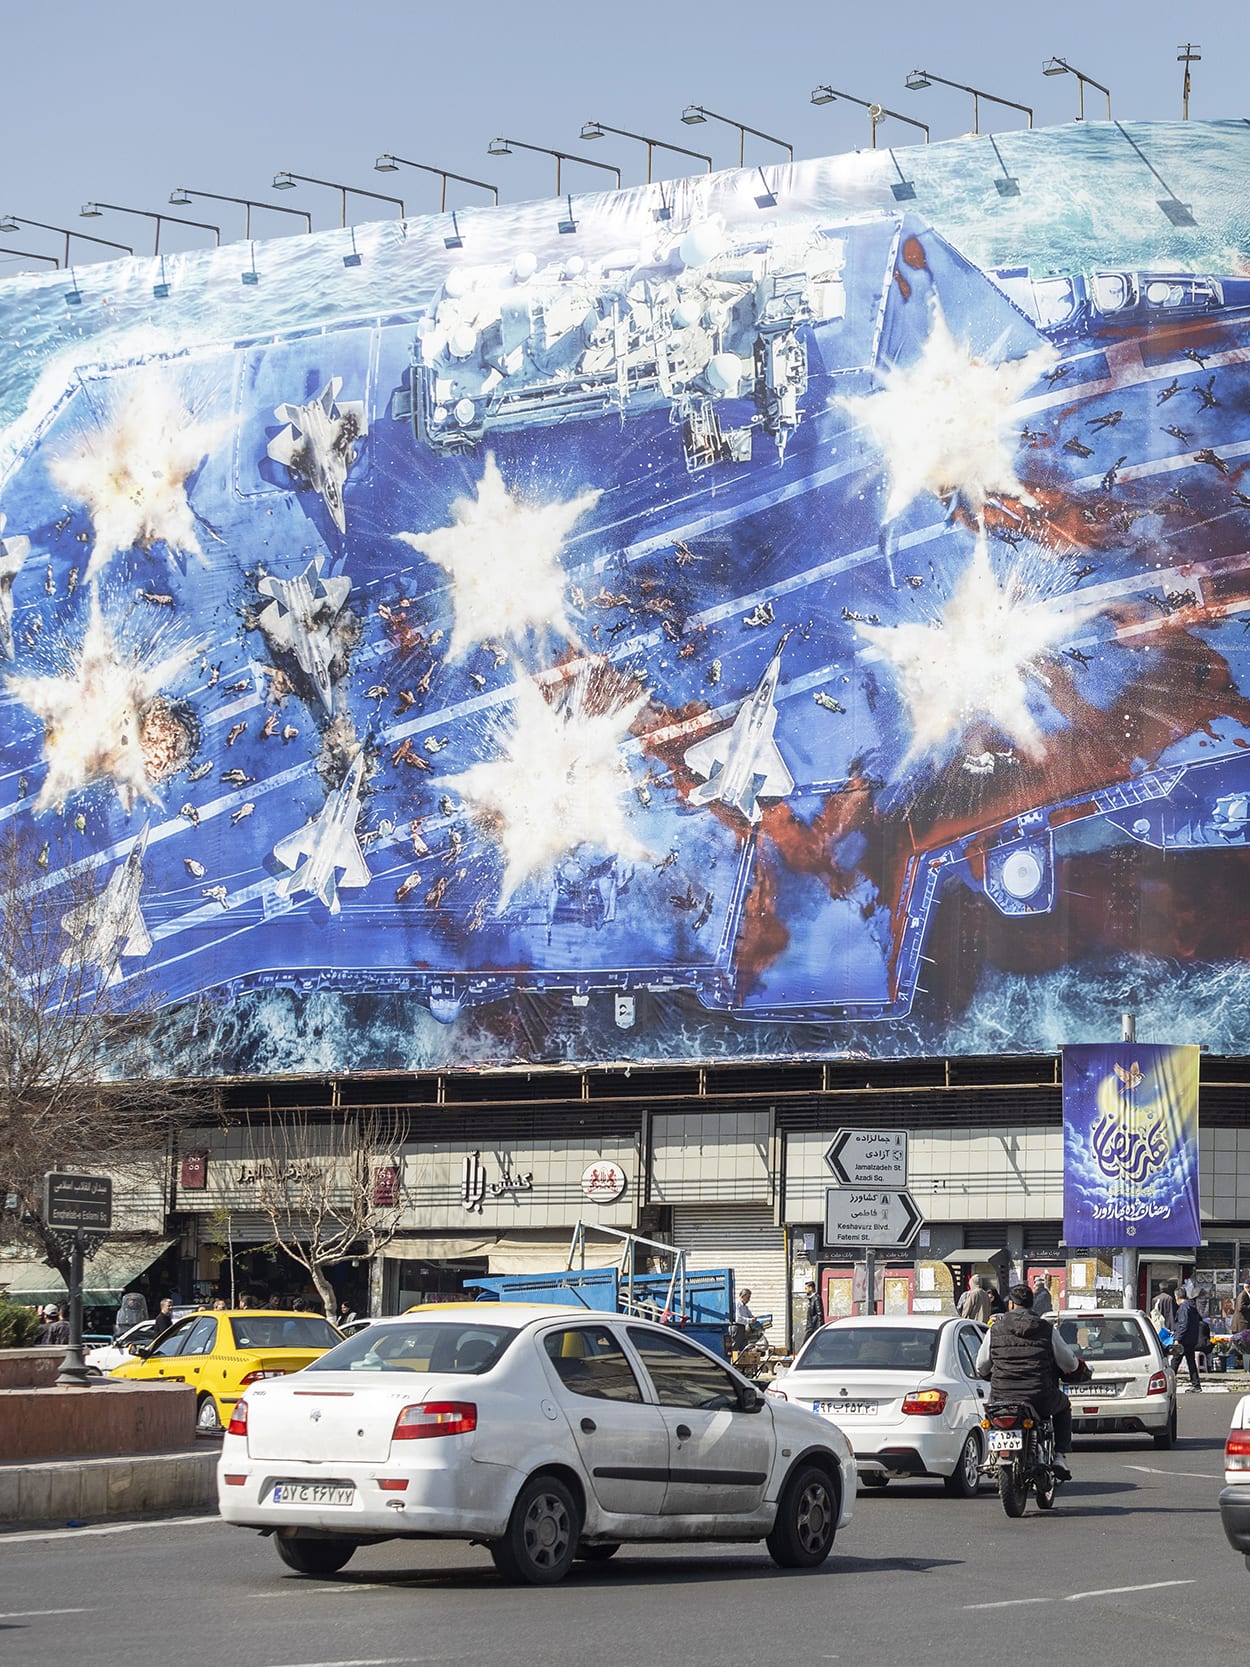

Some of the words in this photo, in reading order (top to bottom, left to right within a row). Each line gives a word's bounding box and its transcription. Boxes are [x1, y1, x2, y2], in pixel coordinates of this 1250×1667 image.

[856, 1134, 891, 1144] جمالزاده
[865, 1149, 890, 1160] آزادی
[488, 1171, 531, 1195] کفش
[849, 1193, 878, 1203] کشاورز
[850, 1209, 877, 1218] فاطمی
